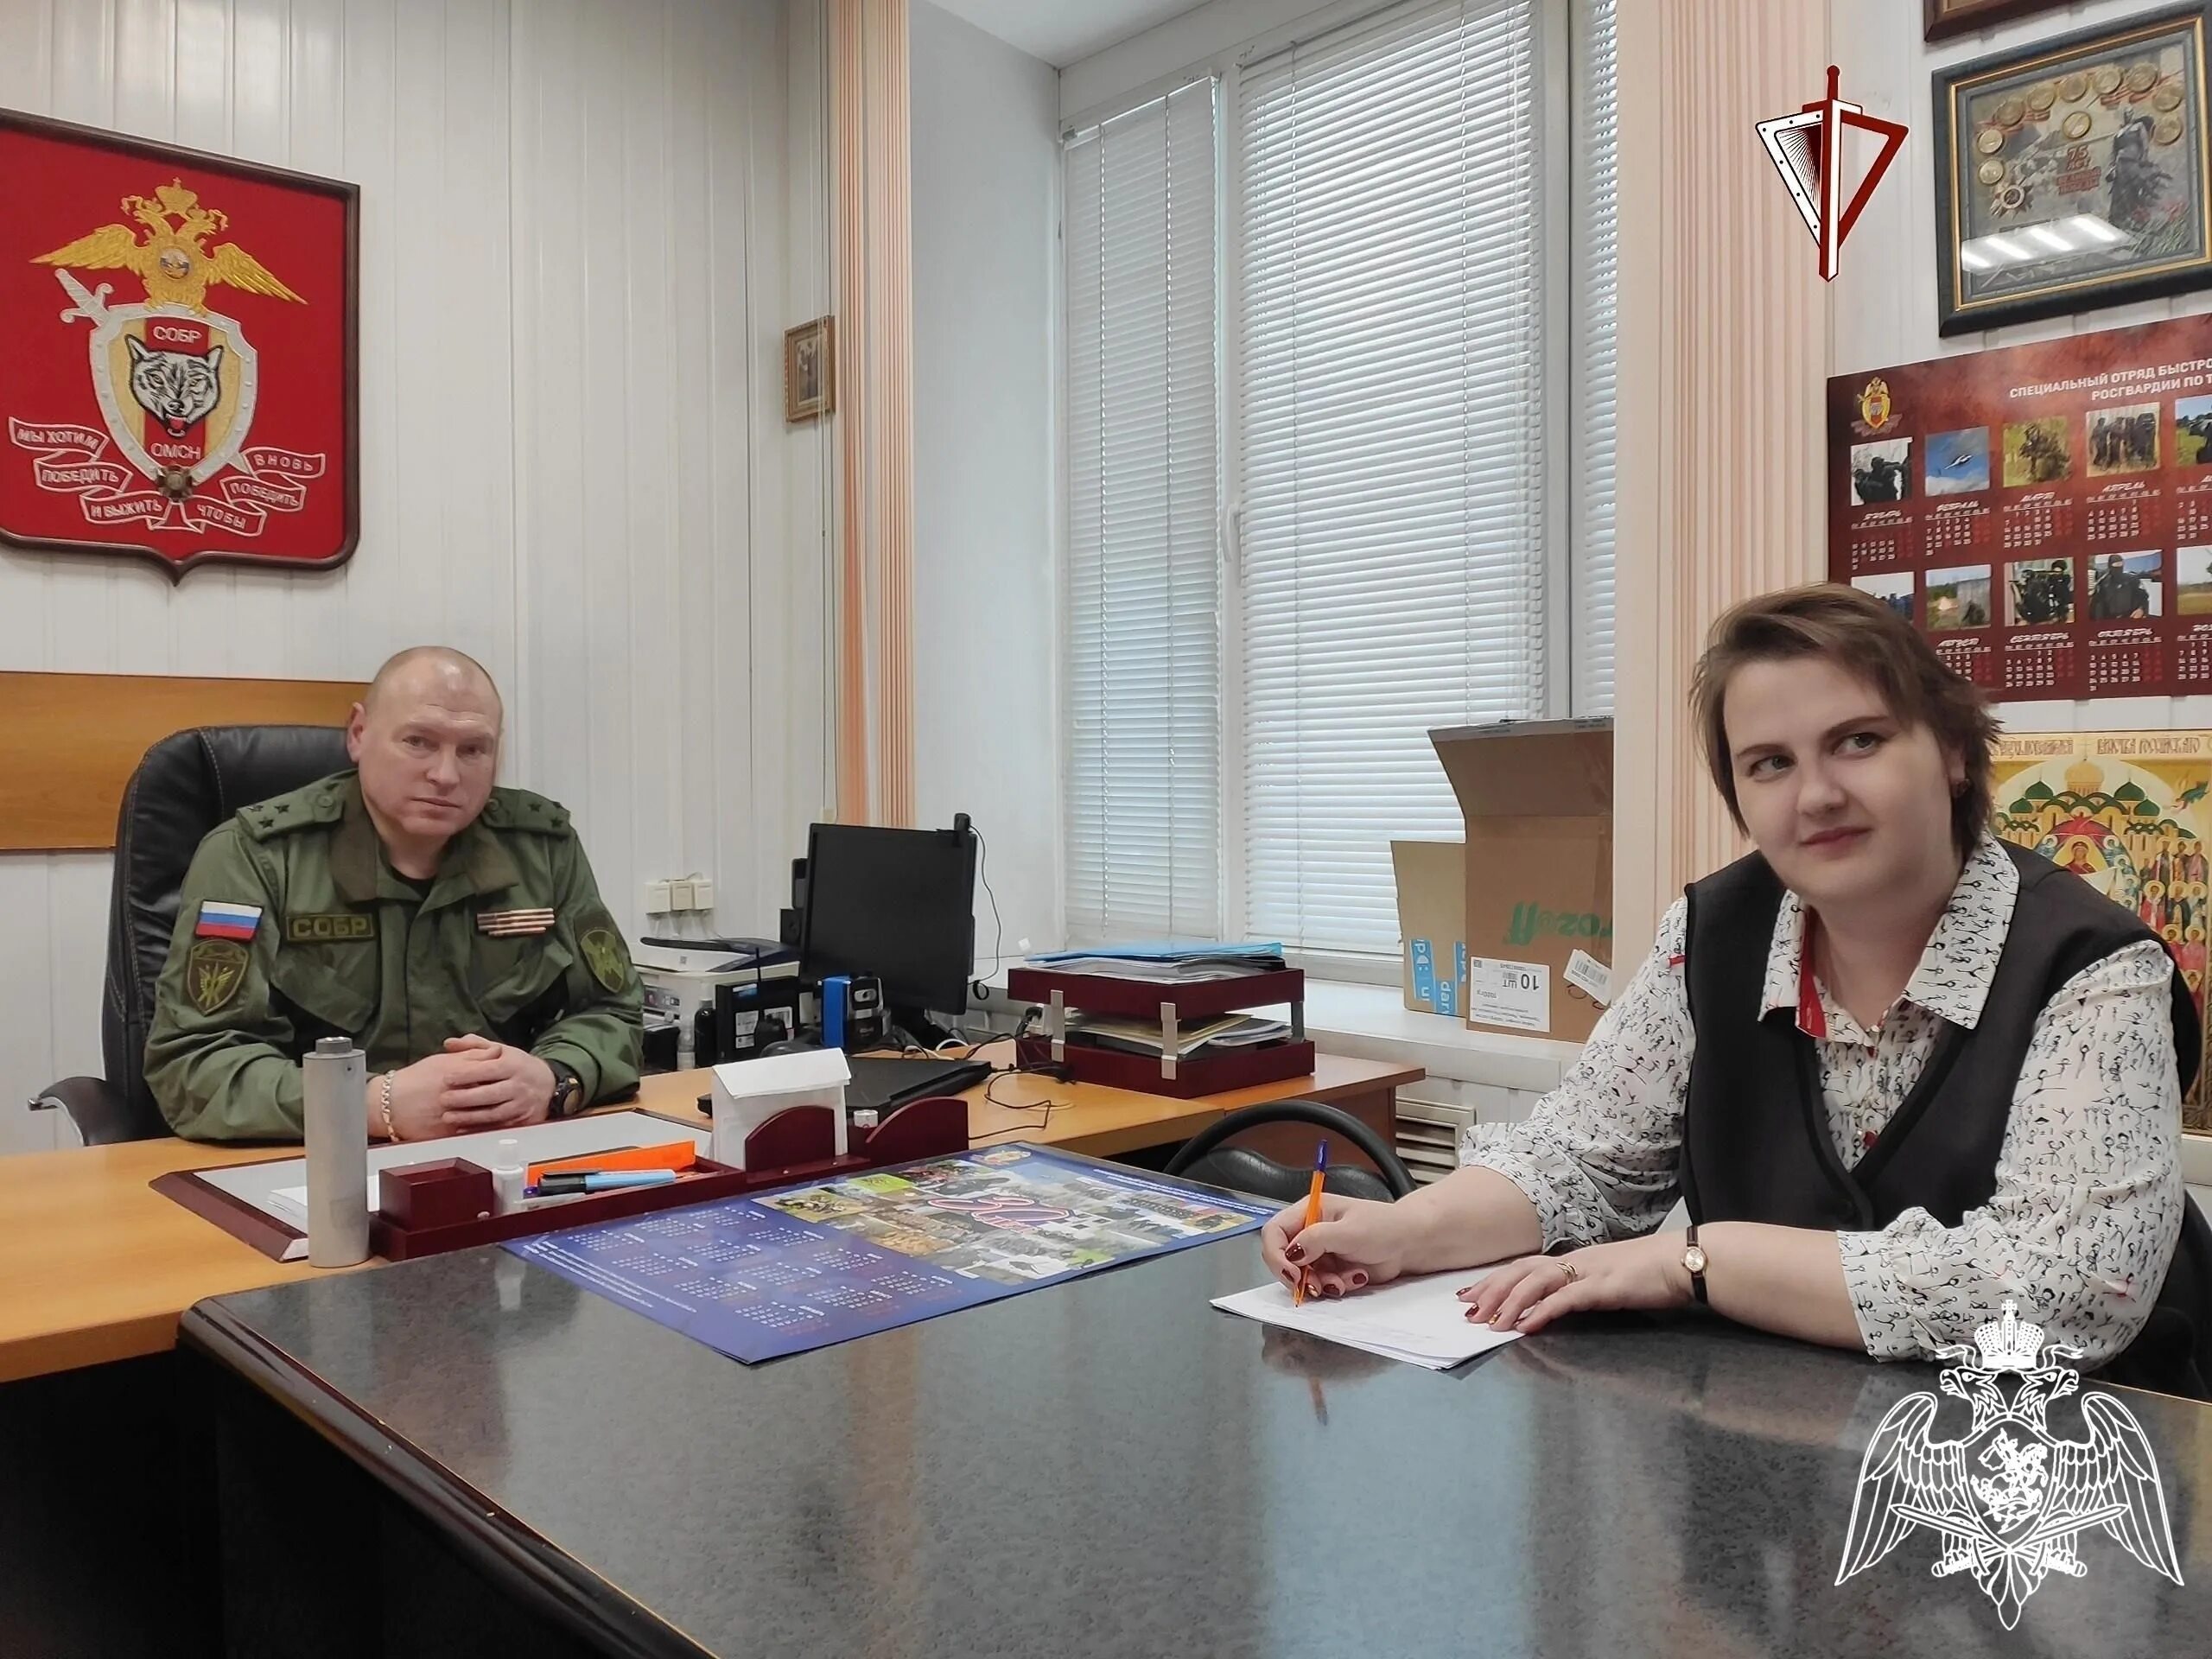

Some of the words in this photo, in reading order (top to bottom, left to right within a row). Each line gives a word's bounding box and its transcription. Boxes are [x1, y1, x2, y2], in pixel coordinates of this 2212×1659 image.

[153, 326, 202, 344] СОБР
[2009, 373, 2109, 398] СПЕЦИАЛЬНЫЙ
[2111, 367, 2156, 384] ОТРЯД
[2091, 378, 2182, 401] РОСГВАРДИИ
[2183, 375, 2204, 388] ПО
[16, 429, 45, 443] МЫ
[47, 430, 99, 450] ХОТИМ
[150, 442, 201, 460] ОМСН
[253, 454, 314, 472] ВНОВЬ
[41, 467, 119, 485] ПОБЕДИТЬ
[230, 482, 300, 507] ПОБЕДИТЬ
[197, 504, 247, 529] ЧТОБЫ
[293, 918, 367, 938] СОБР
[1521, 973, 1540, 991] 10
